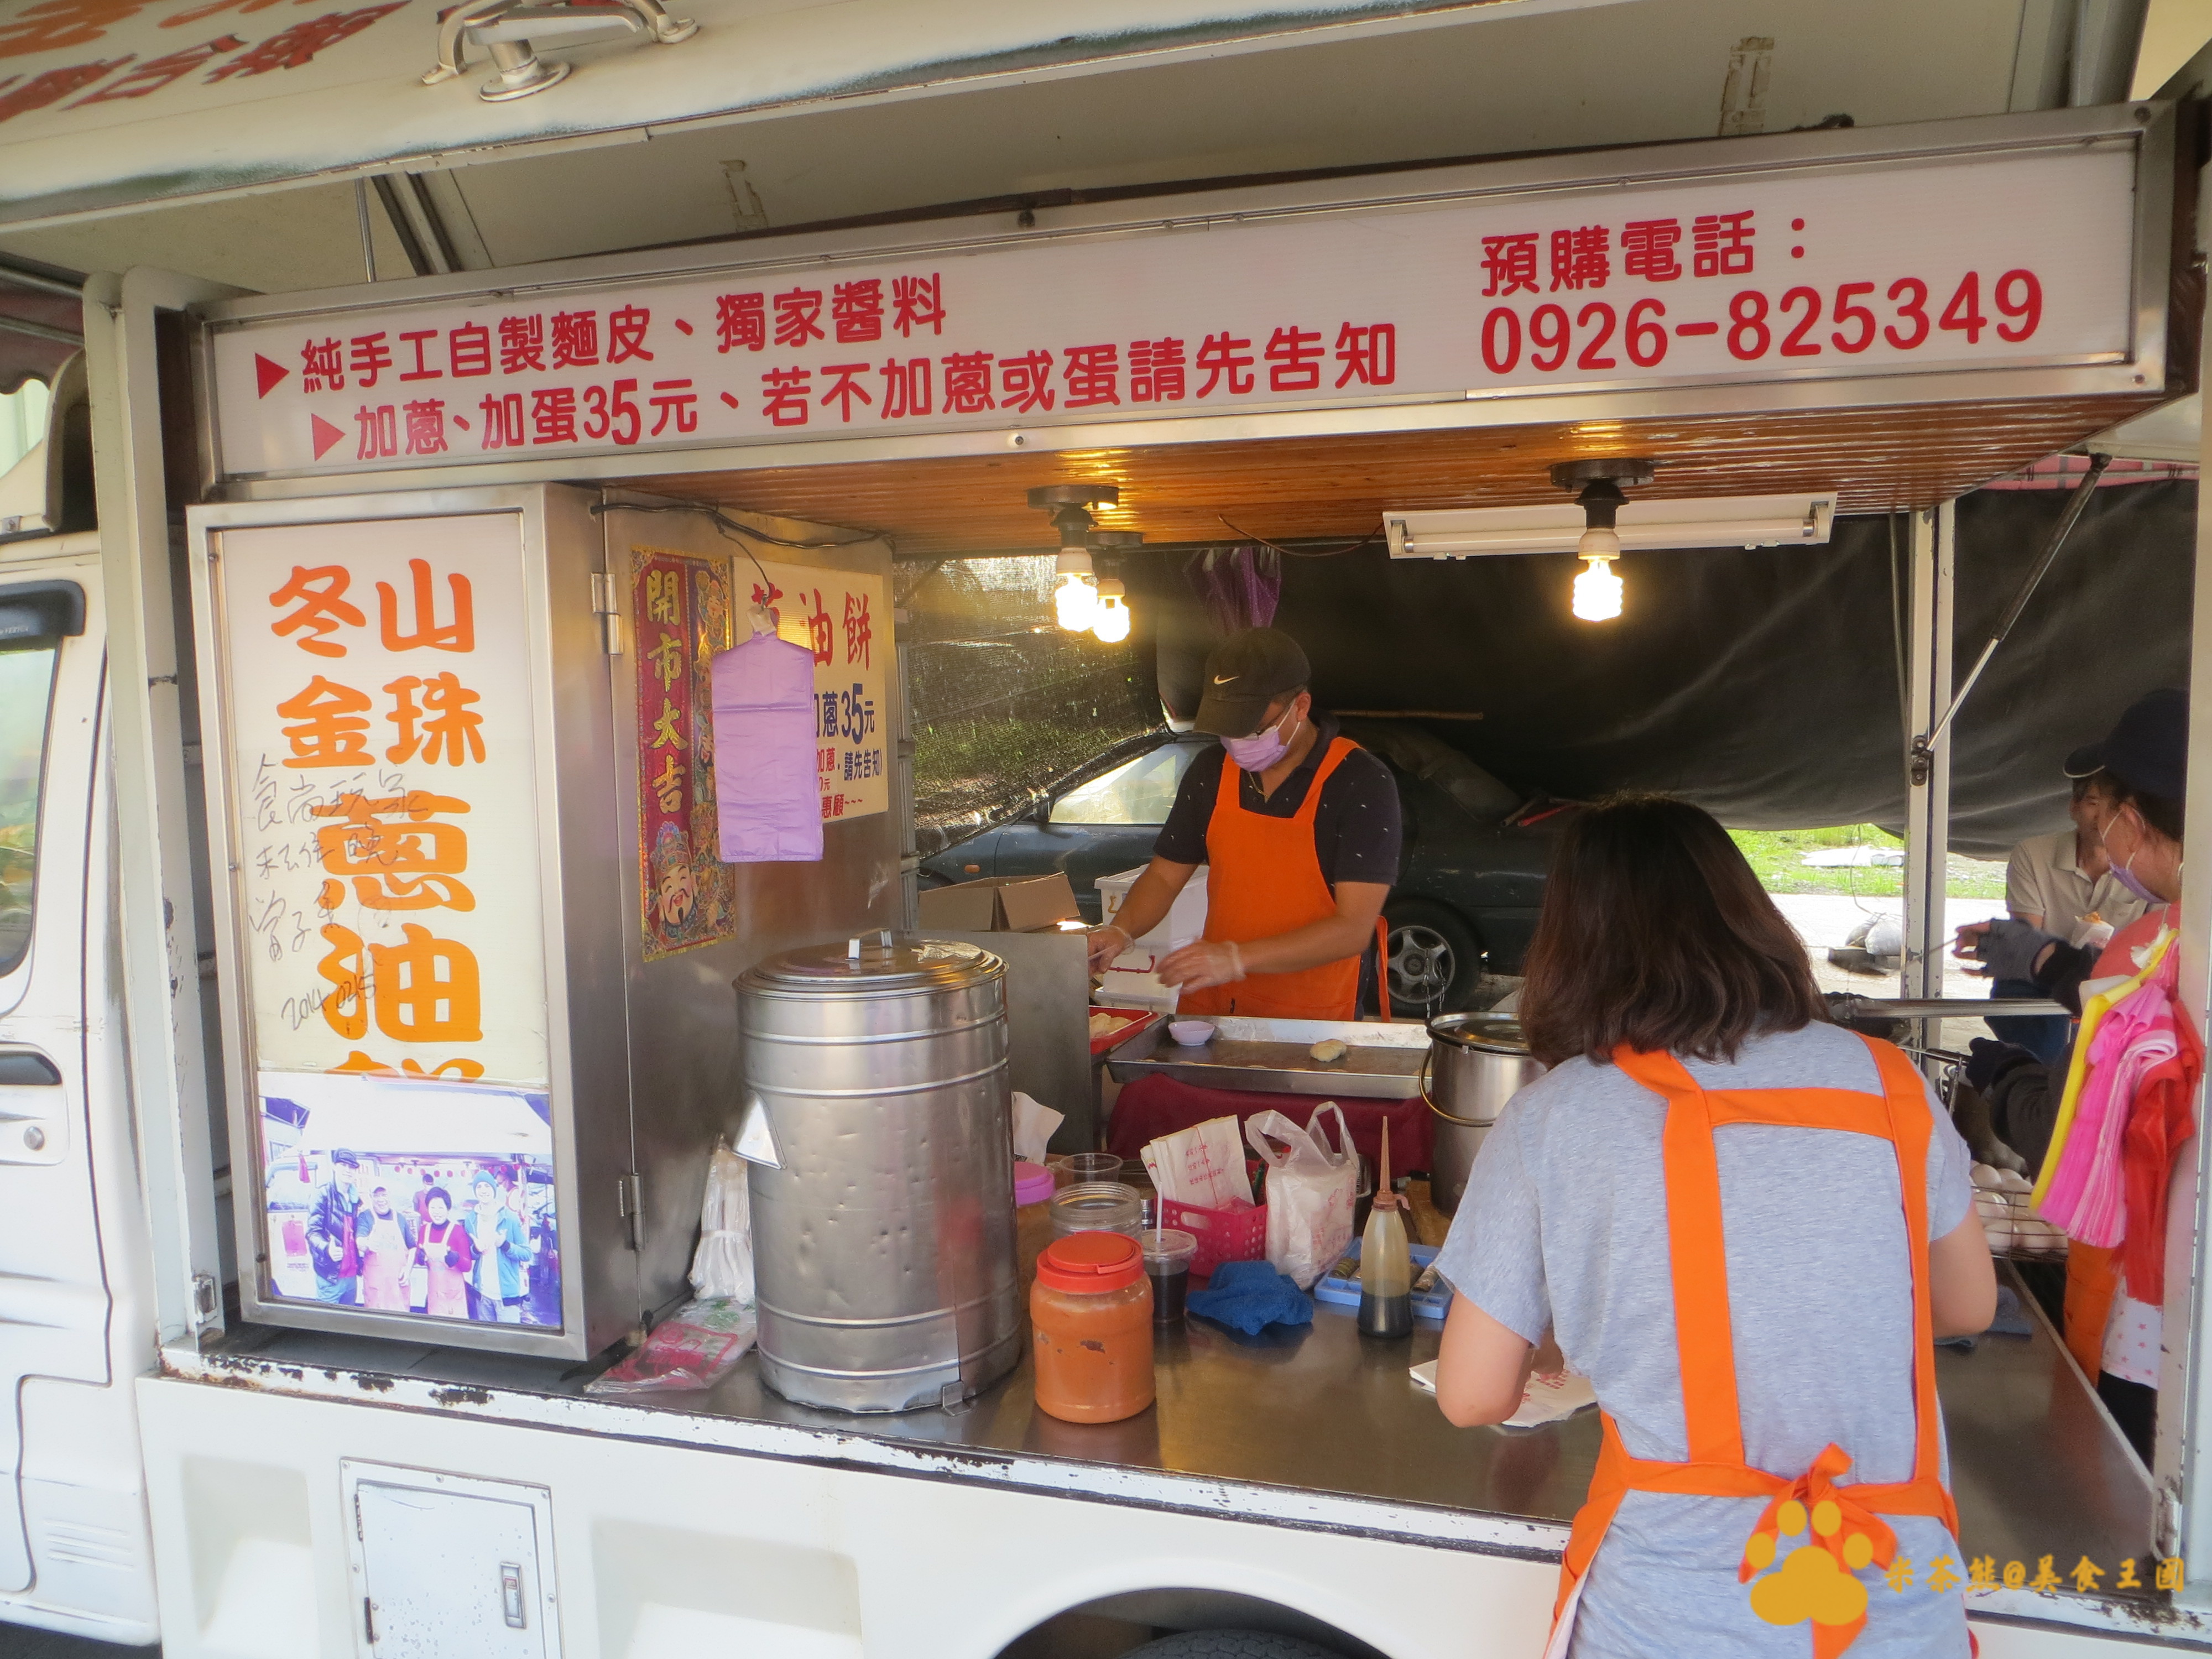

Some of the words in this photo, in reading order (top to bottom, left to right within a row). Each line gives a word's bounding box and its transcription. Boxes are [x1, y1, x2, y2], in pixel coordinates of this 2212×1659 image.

[301, 272, 947, 394] 純手工自製麵皮、獨家醬料
[1481, 269, 2043, 375] 0926-825349
[269, 558, 475, 659] 冬山
[277, 671, 486, 769] 金珠
[646, 570, 689, 814] 開市大吉
[311, 790, 485, 1079] 蔥油
